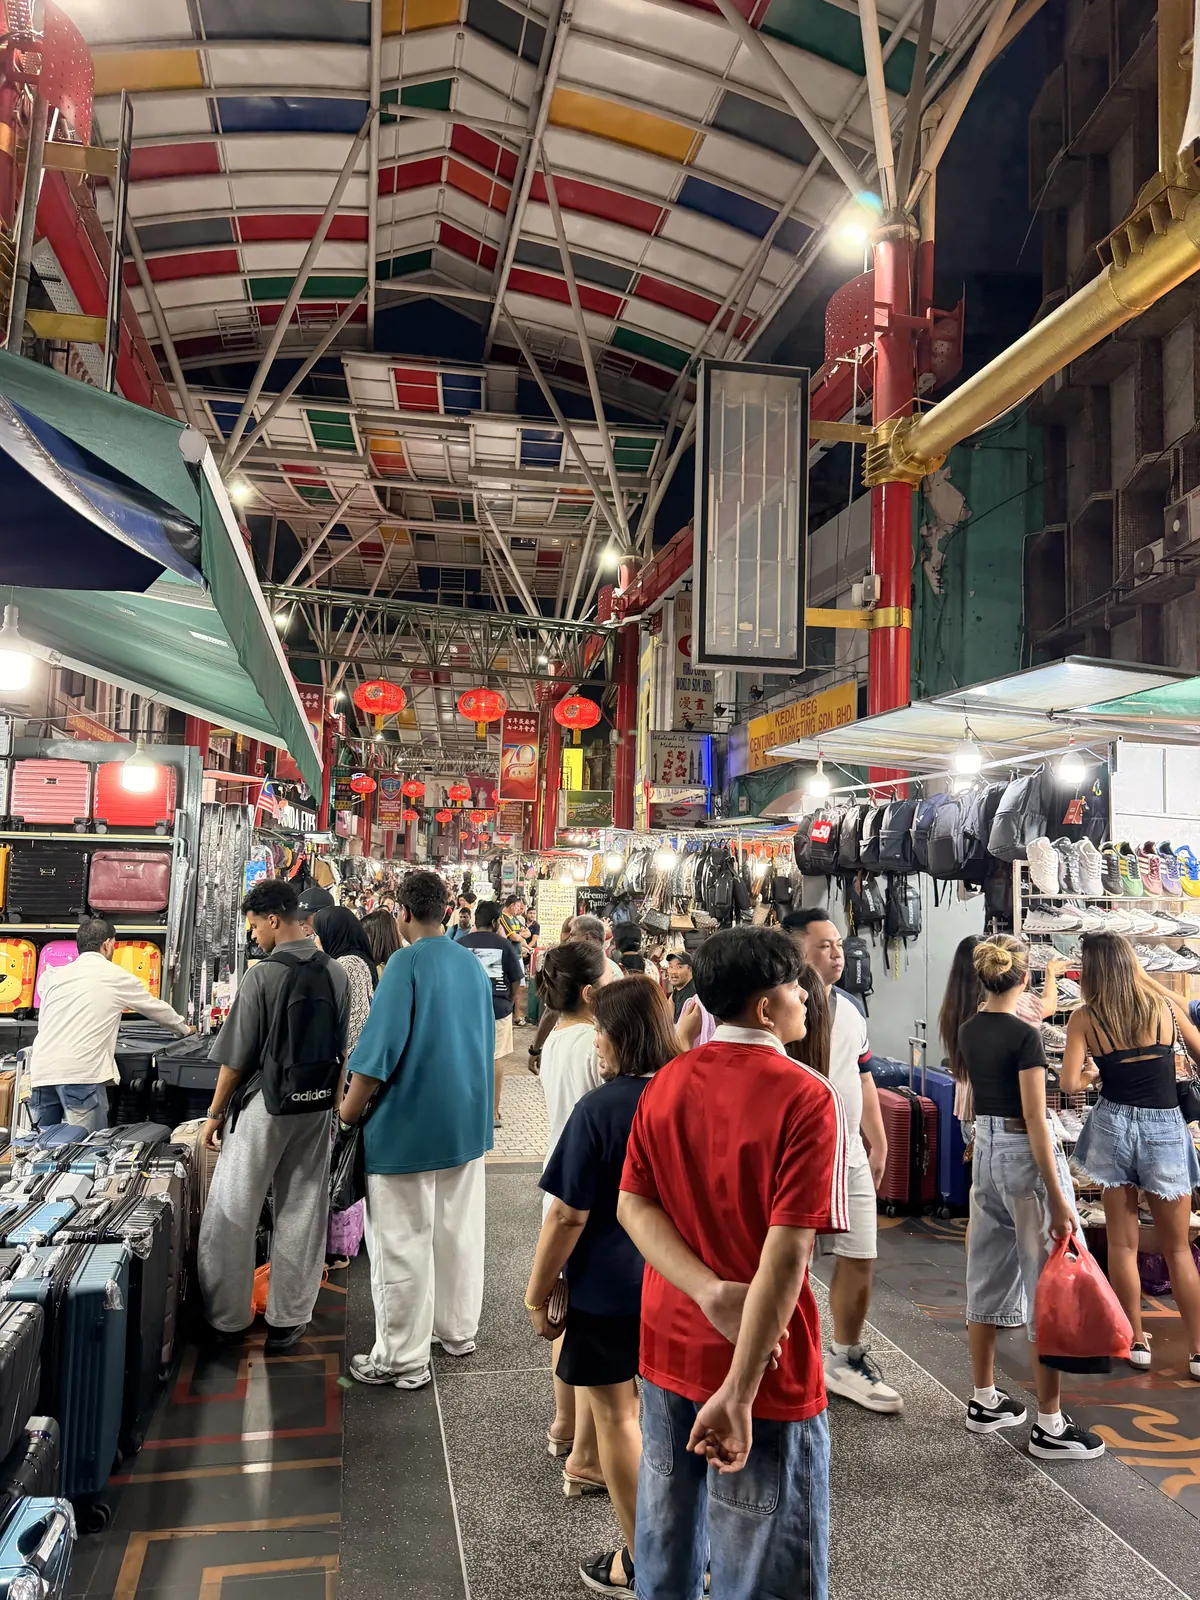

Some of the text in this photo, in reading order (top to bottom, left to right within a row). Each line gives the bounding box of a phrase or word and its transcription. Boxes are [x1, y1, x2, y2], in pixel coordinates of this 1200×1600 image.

[775, 698, 818, 727] KEDAI BEG
[750, 732, 777, 753] CENTINEL
[778, 717, 816, 744] MARKETING
[503, 743, 536, 764] 70
[301, 810, 316, 832] EYES
[578, 889, 608, 899] Xtreme
[291, 1088, 332, 1102] adidas
